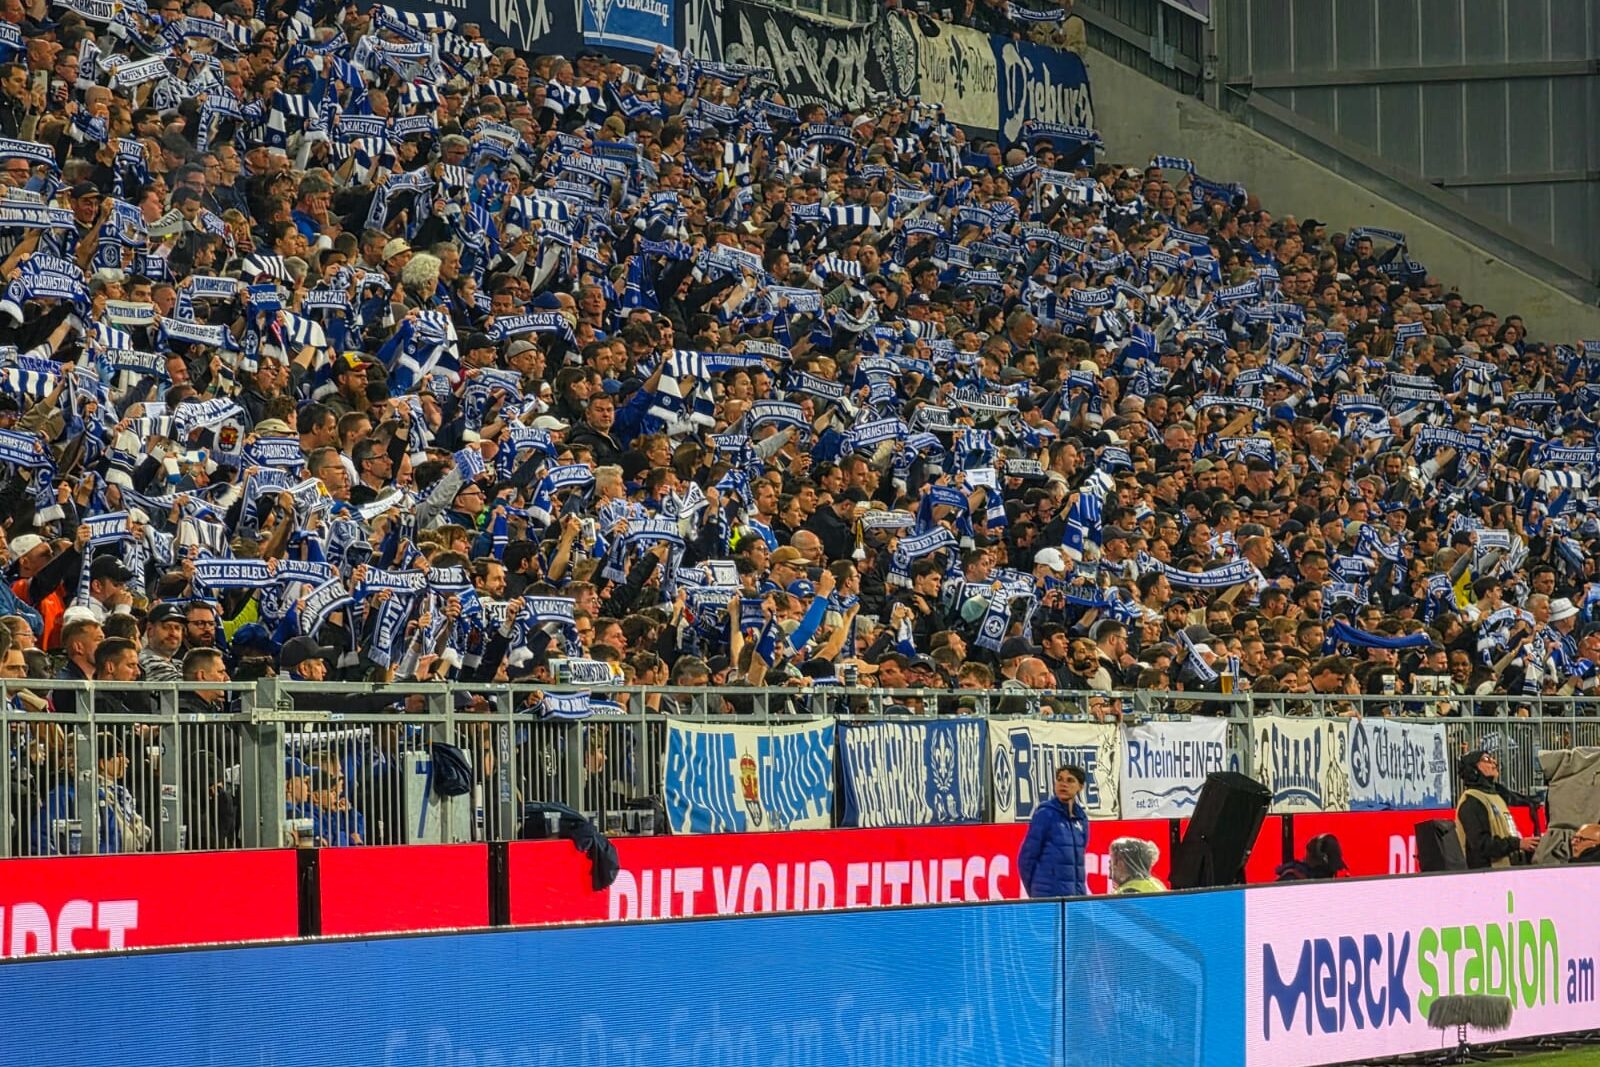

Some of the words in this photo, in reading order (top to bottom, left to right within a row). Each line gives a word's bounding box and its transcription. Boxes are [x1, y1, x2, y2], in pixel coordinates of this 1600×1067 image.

[504, 313, 553, 331] DARMSTADT
[1128, 738, 1223, 779] RheinHEINER
[1567, 955, 1596, 1005] am
